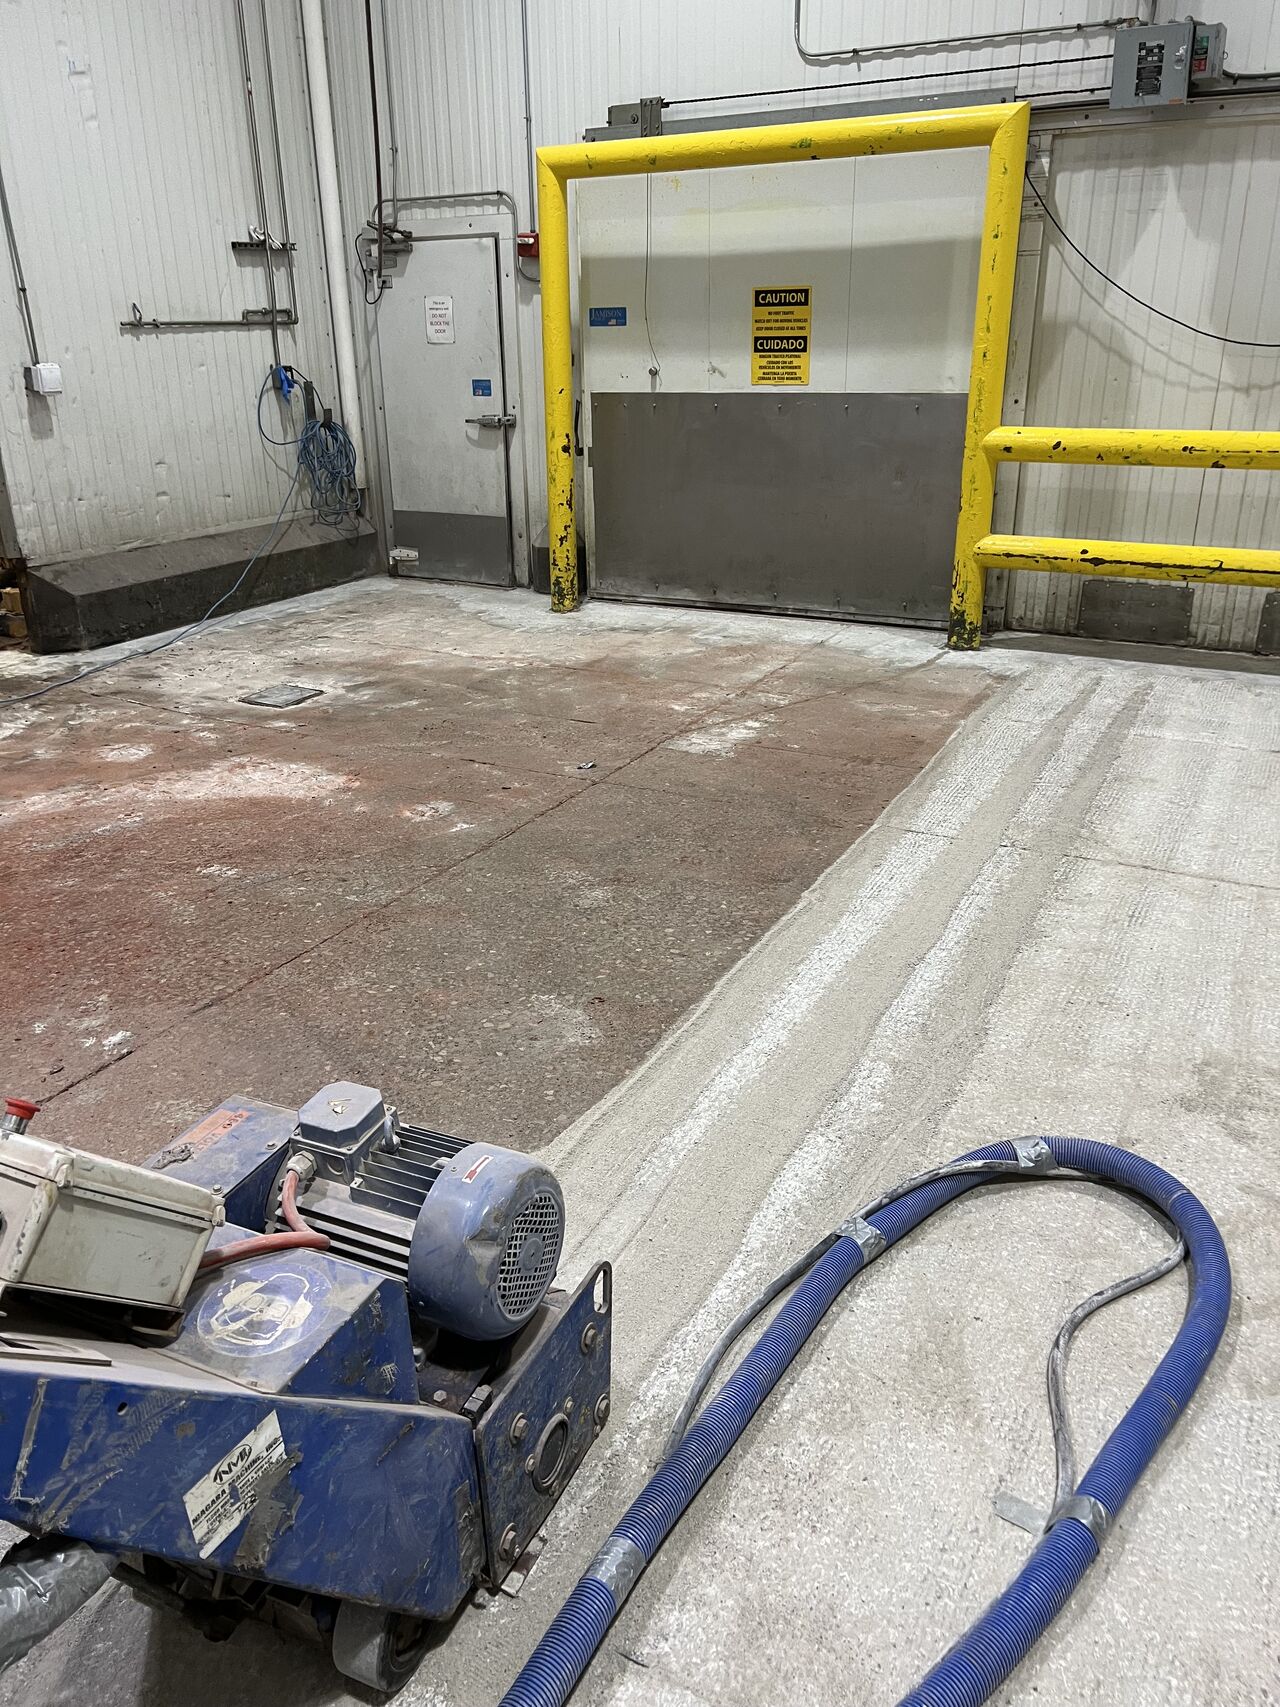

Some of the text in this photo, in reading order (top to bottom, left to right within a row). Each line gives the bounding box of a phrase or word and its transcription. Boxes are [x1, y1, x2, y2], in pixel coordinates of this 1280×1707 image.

[758, 292, 804, 304] CAUTION
[591, 309, 622, 320] JAMISON
[757, 339, 804, 349] CUIDADO
[192, 1488, 227, 1526] NIAGARA
